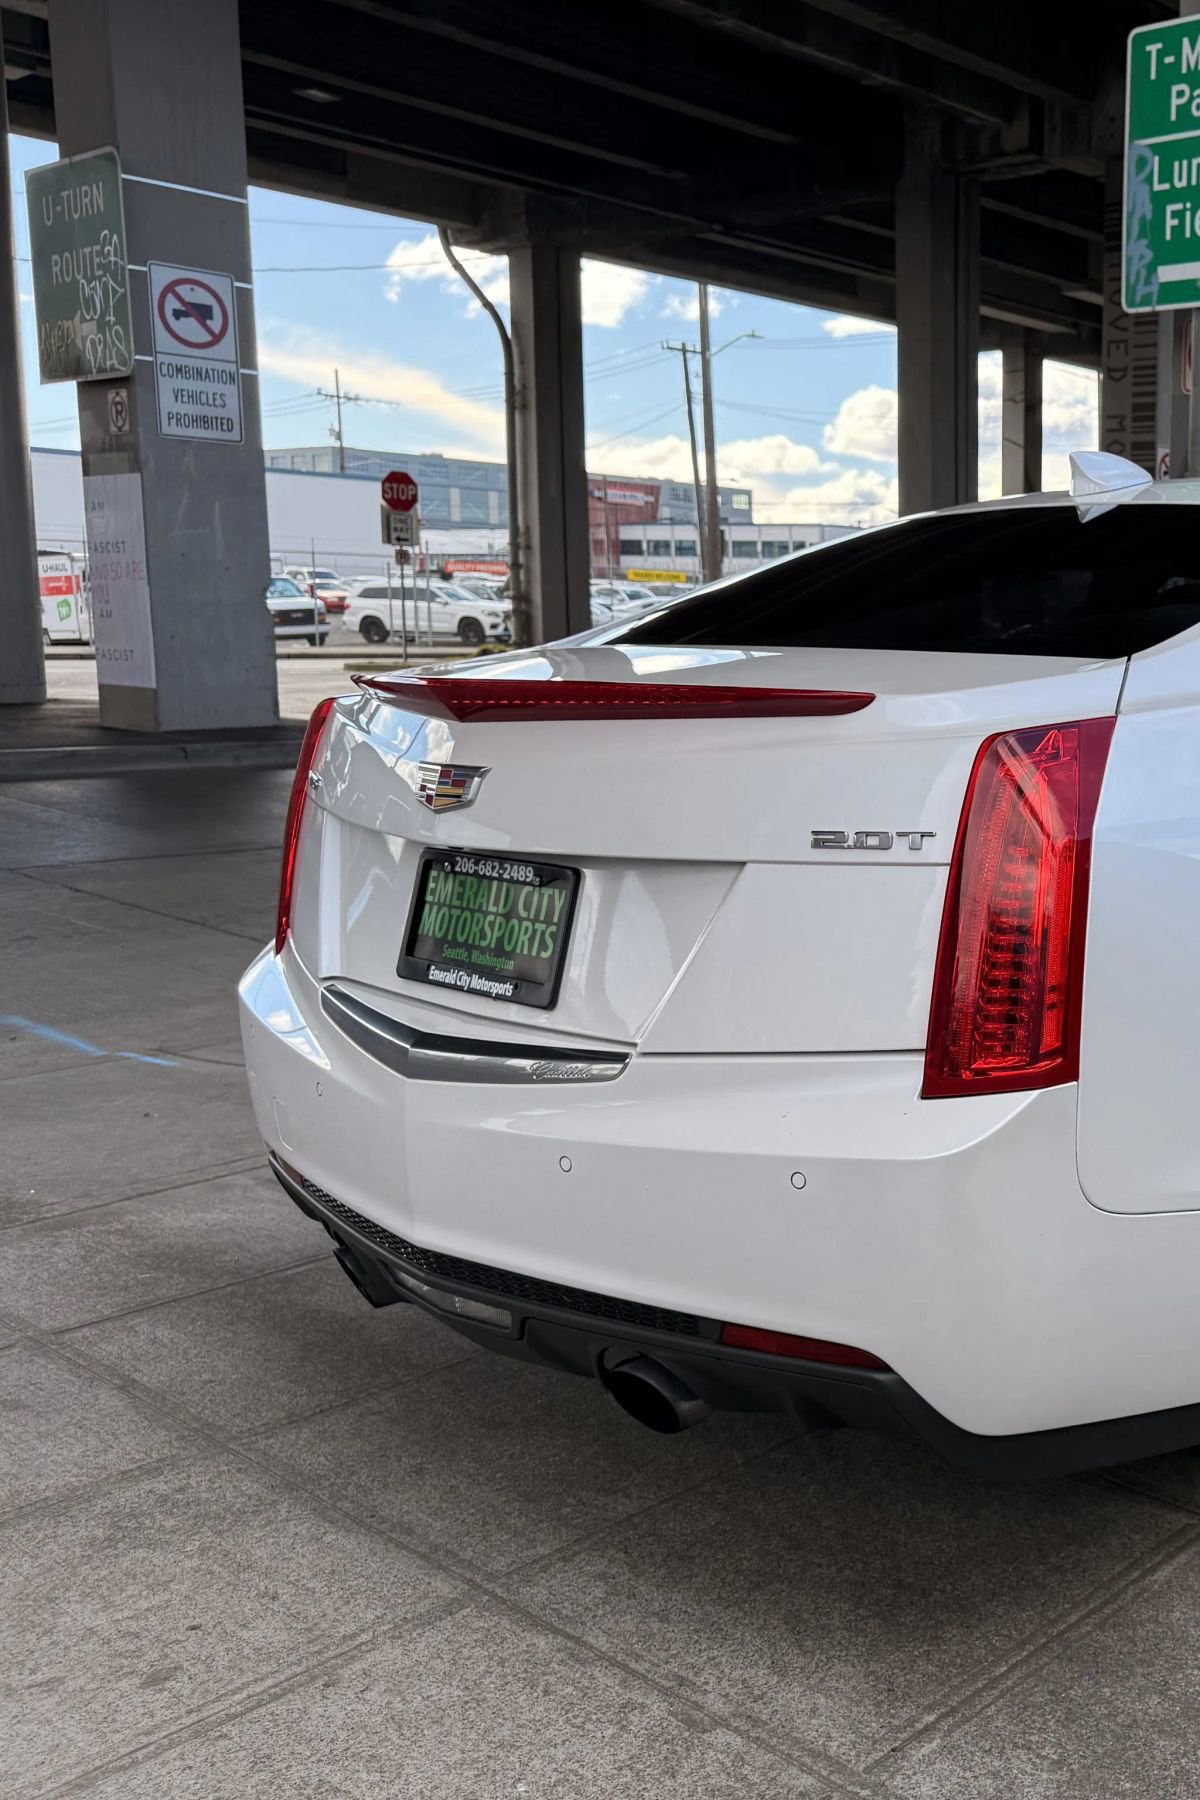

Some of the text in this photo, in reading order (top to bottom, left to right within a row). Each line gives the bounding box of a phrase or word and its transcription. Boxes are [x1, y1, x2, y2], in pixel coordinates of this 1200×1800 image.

[42, 181, 104, 227] U-TURN
[51, 244, 104, 285] ROUTE
[159, 361, 236, 386] COMBINATION
[172, 387, 226, 409] VEHICLES
[167, 411, 234, 433] PROHIBITED
[383, 483, 416, 500] STOP
[810, 830, 937, 851] 2.0T
[454, 856, 535, 882] 206-682-2489
[425, 870, 566, 923] EMERALD CITY
[418, 903, 558, 960] MOTORSPORTS
[442, 944, 514, 971] Seattle, Washington
[428, 965, 514, 997] Emerald City Motorsports
